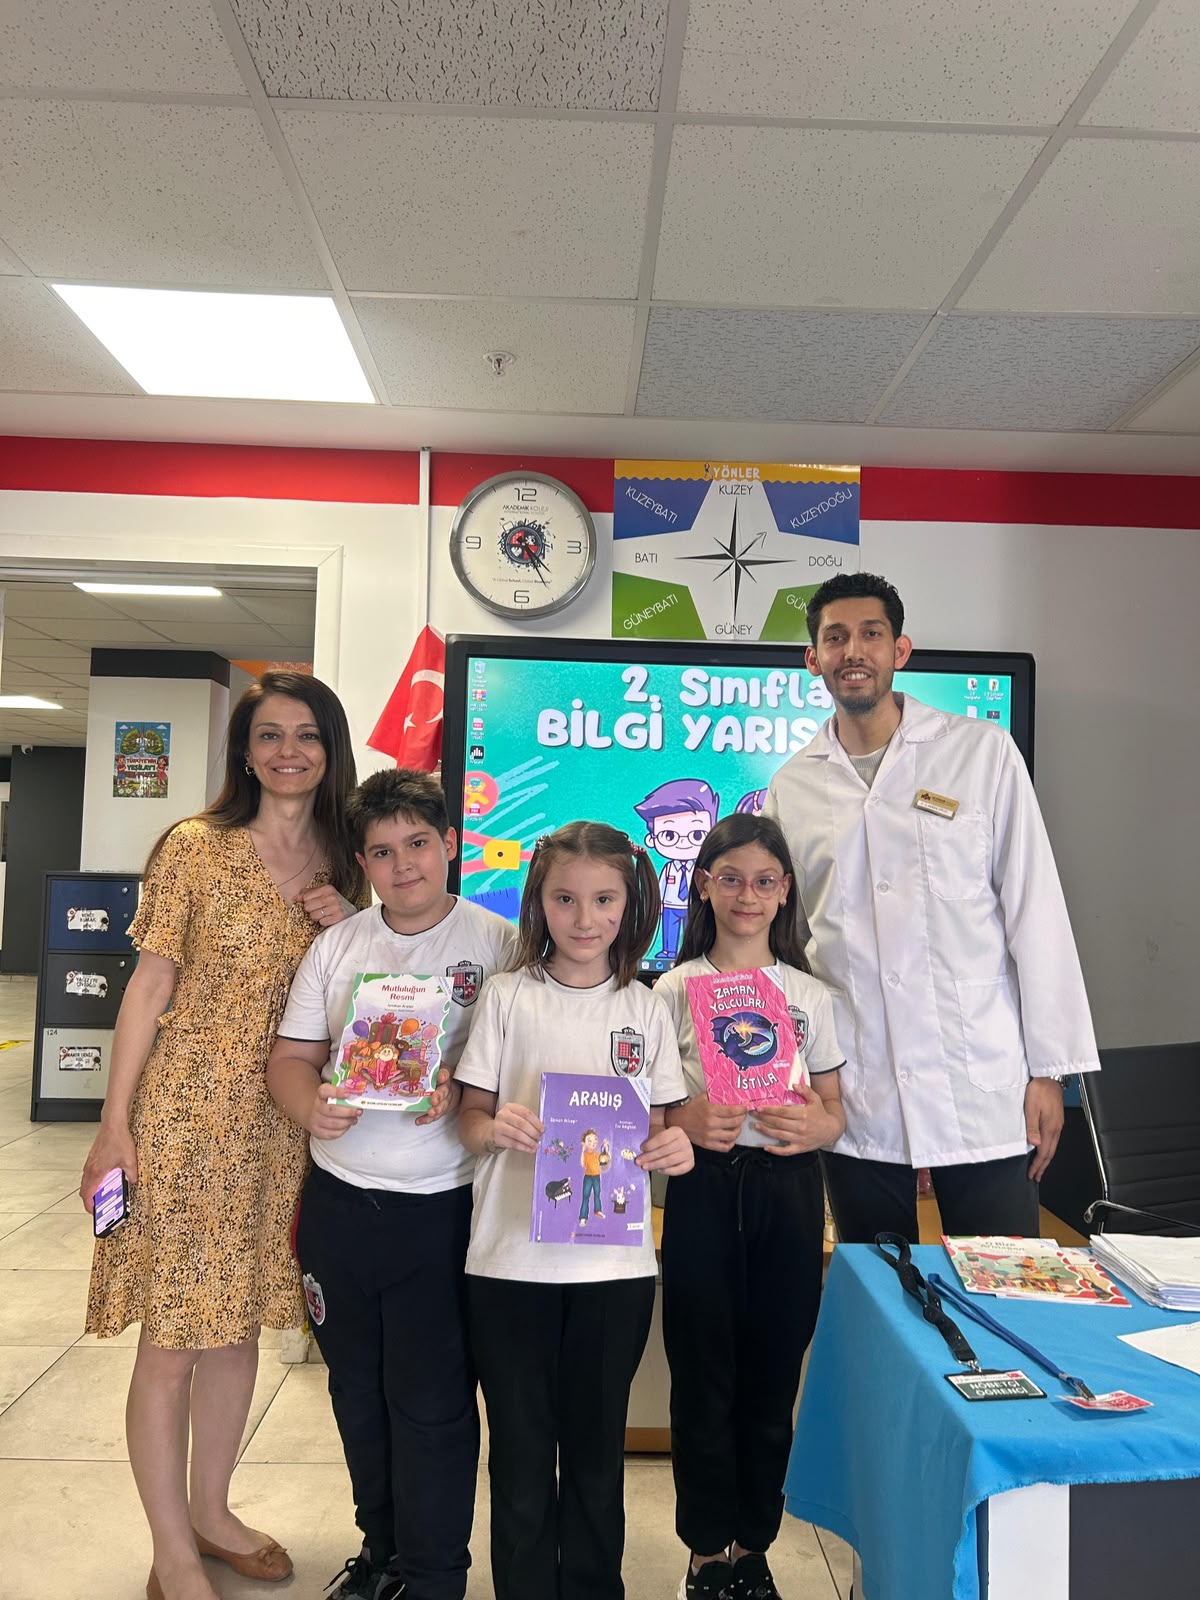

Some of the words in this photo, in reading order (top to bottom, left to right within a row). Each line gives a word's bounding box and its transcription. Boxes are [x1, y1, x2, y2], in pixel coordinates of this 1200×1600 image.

[713, 464, 760, 479] YÖNLER
[514, 487, 537, 502] 12
[719, 484, 753, 496] KUZEY
[625, 485, 678, 524] KUZEYBATI
[790, 487, 853, 529] KUZEYDOĞU
[465, 535, 482, 549] 9
[566, 540, 582, 554] 3
[634, 552, 658, 563] BATI
[808, 554, 843, 567] DOĞU
[513, 589, 530, 604] 6
[623, 593, 679, 630] GÜNEYBATI
[714, 622, 753, 635] GÜNEY
[621, 665, 661, 703] 2.
[537, 698, 664, 751] BİLGİ
[381, 984, 426, 994] Mutluluğun
[713, 985, 756, 1000] ZAMAN
[390, 993, 415, 1001] Resmi
[709, 997, 766, 1014] YOLCULARI
[568, 1090, 623, 1112] ARAYIŞ
[969, 1378, 1020, 1390] NÖBETÇİ
